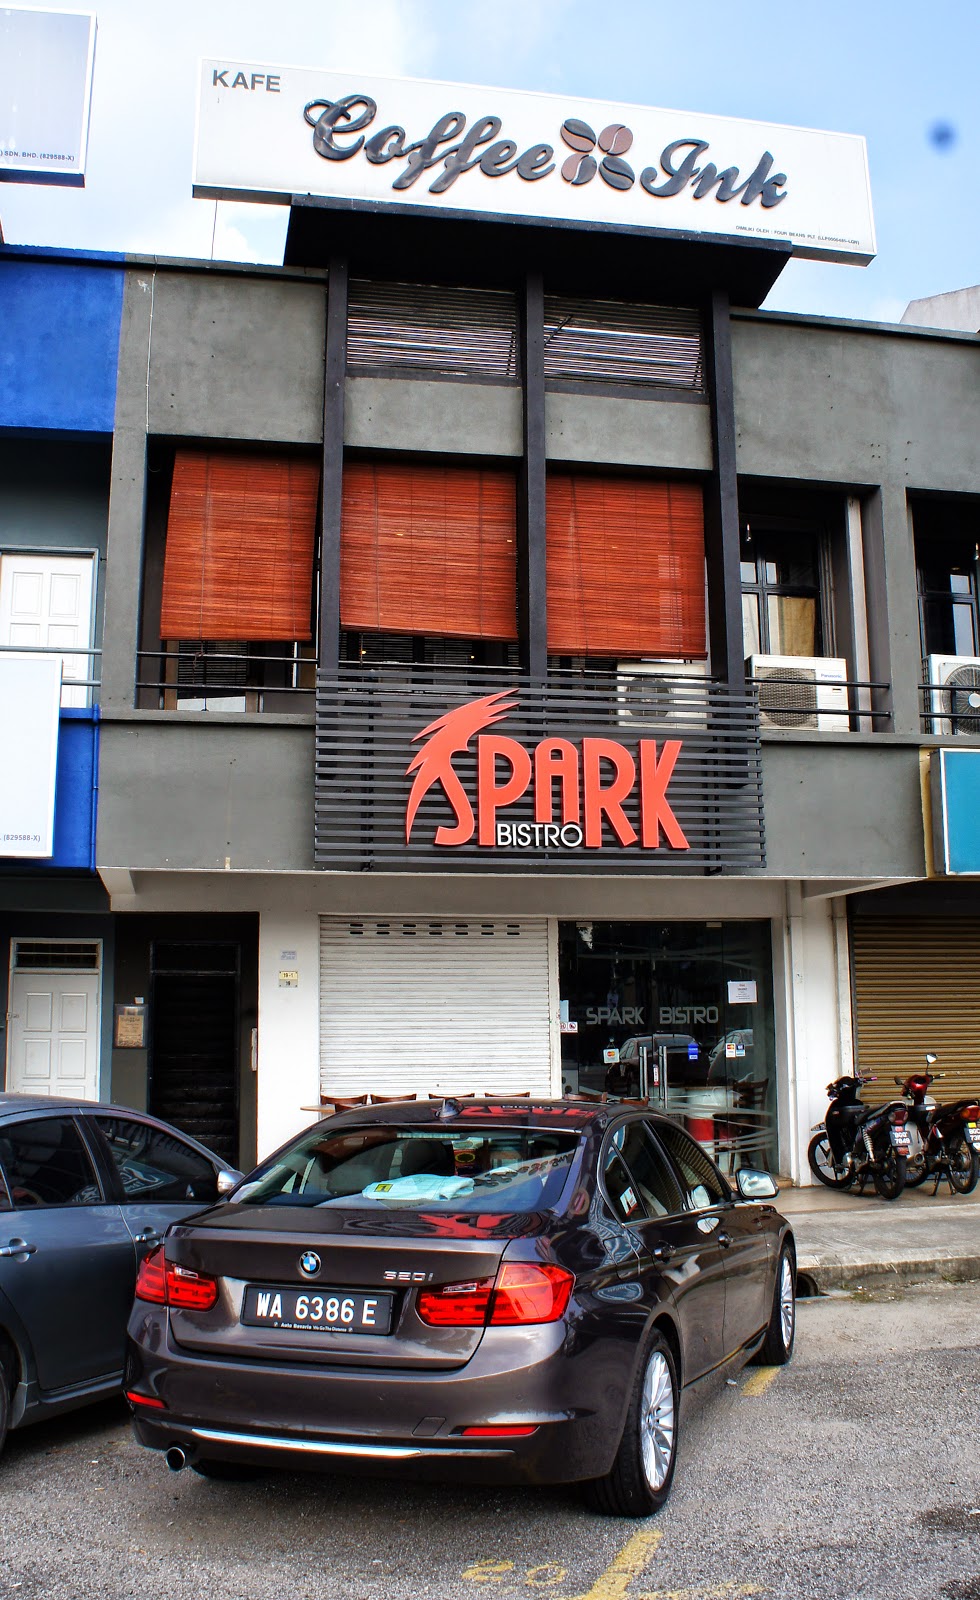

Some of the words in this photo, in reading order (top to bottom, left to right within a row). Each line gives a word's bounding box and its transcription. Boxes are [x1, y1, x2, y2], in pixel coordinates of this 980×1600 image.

[212, 69, 281, 93] KAFE
[303, 94, 556, 193] Coffee
[640, 138, 788, 208] Ink
[404, 688, 691, 850] SPARK
[3, 834, 41, 843] (829588-X)
[496, 823, 583, 848] BISTRO
[586, 1006, 645, 1025] SPARK
[659, 1005, 719, 1025] BISTRO
[383, 1270, 434, 1283] 320i
[256, 1292, 283, 1319] WA
[295, 1295, 355, 1323] 6386
[361, 1299, 378, 1325] E
